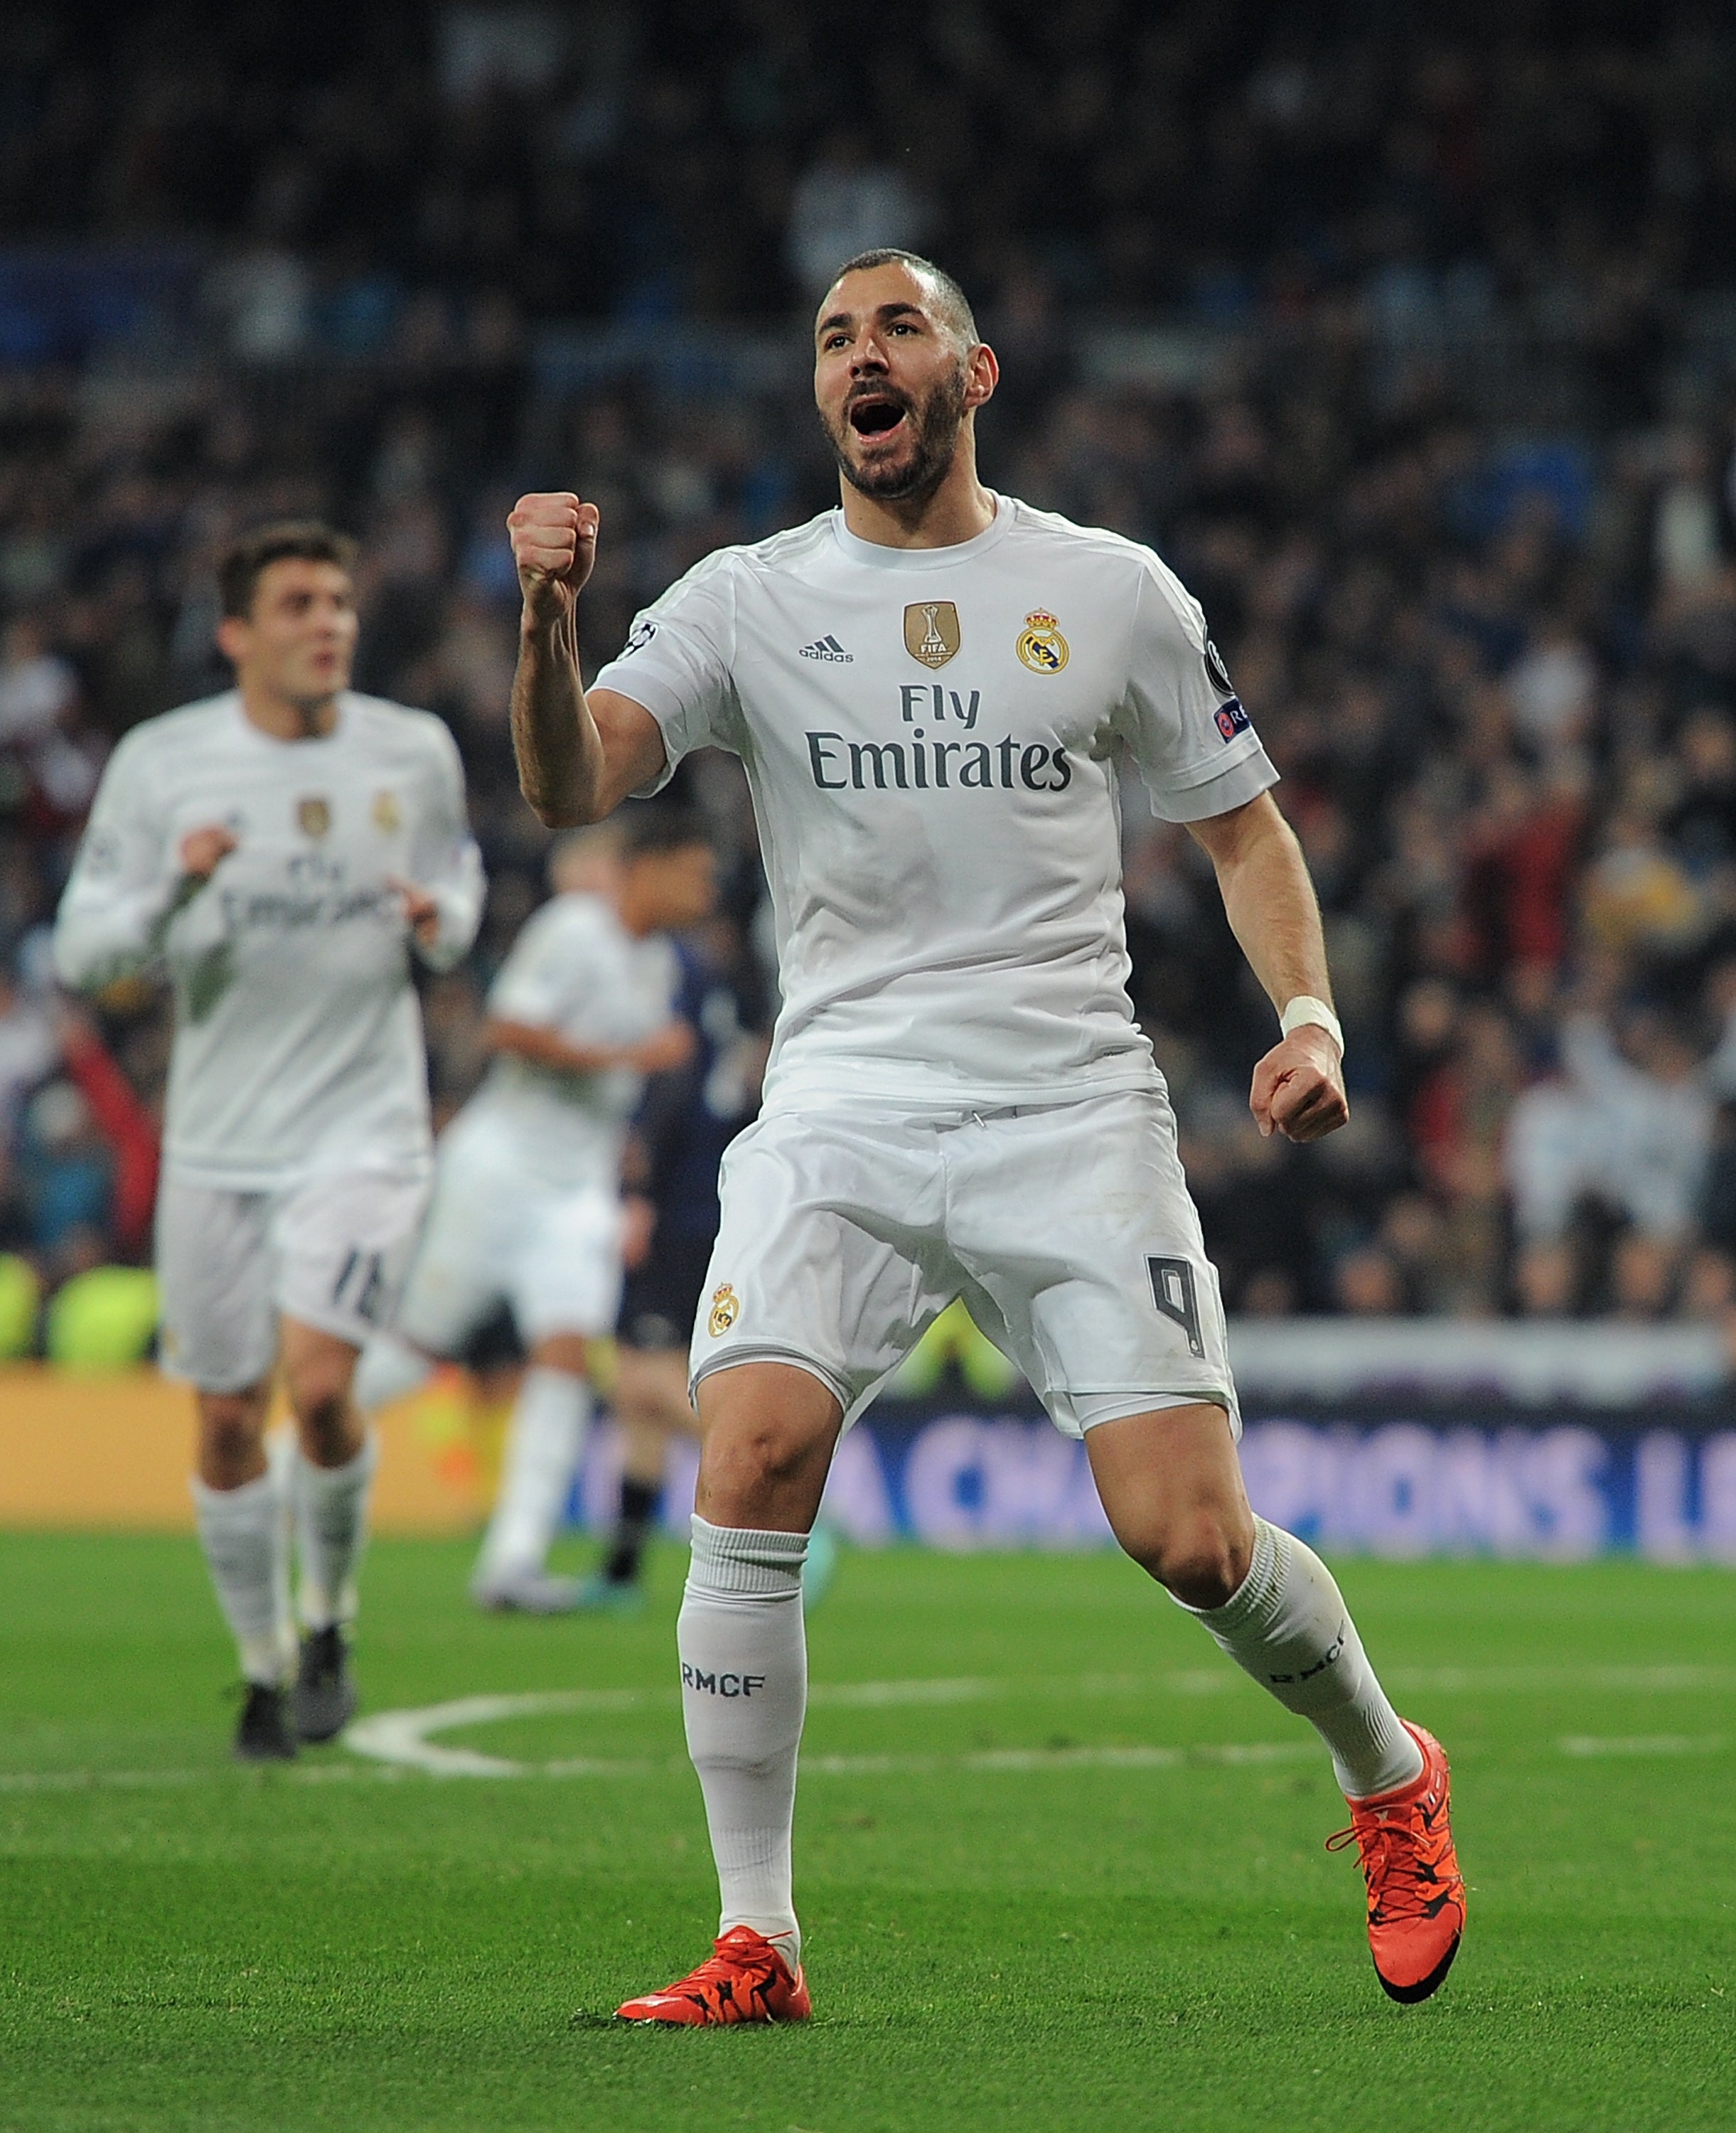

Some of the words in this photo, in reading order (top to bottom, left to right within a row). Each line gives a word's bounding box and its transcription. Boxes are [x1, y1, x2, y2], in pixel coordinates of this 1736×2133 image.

[798, 649, 854, 663] adidas
[921, 643, 946, 653] FIFA
[899, 685, 981, 729] Fly
[805, 727, 1072, 792] Emirates
[1144, 1253, 1206, 1359] 9
[908, 1416, 1607, 1561] CHPIONS
[682, 1662, 766, 1698] RMCF
